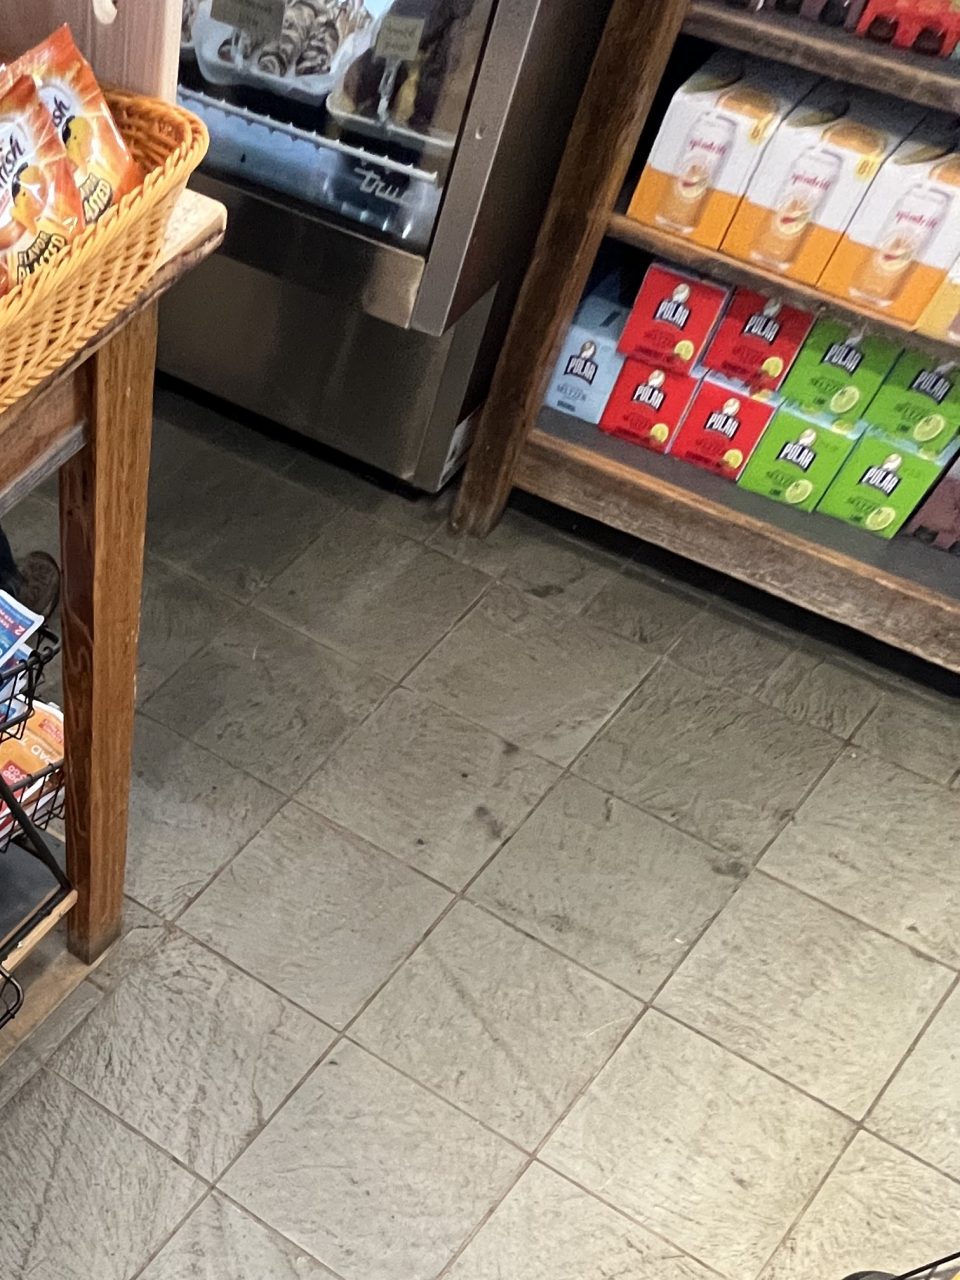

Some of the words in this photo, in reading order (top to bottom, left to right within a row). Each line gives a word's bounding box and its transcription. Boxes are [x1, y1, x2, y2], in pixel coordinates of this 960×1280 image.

[656, 301, 690, 328] POLAR
[744, 314, 780, 343] POLAR
[567, 356, 598, 384] POLAR
[822, 344, 863, 374] POLAR
[633, 383, 666, 411] POLAR
[911, 370, 952, 403] POLAR
[706, 412, 741, 439] POLAR
[778, 442, 816, 471] POLAR
[860, 467, 901, 496] POLAR
